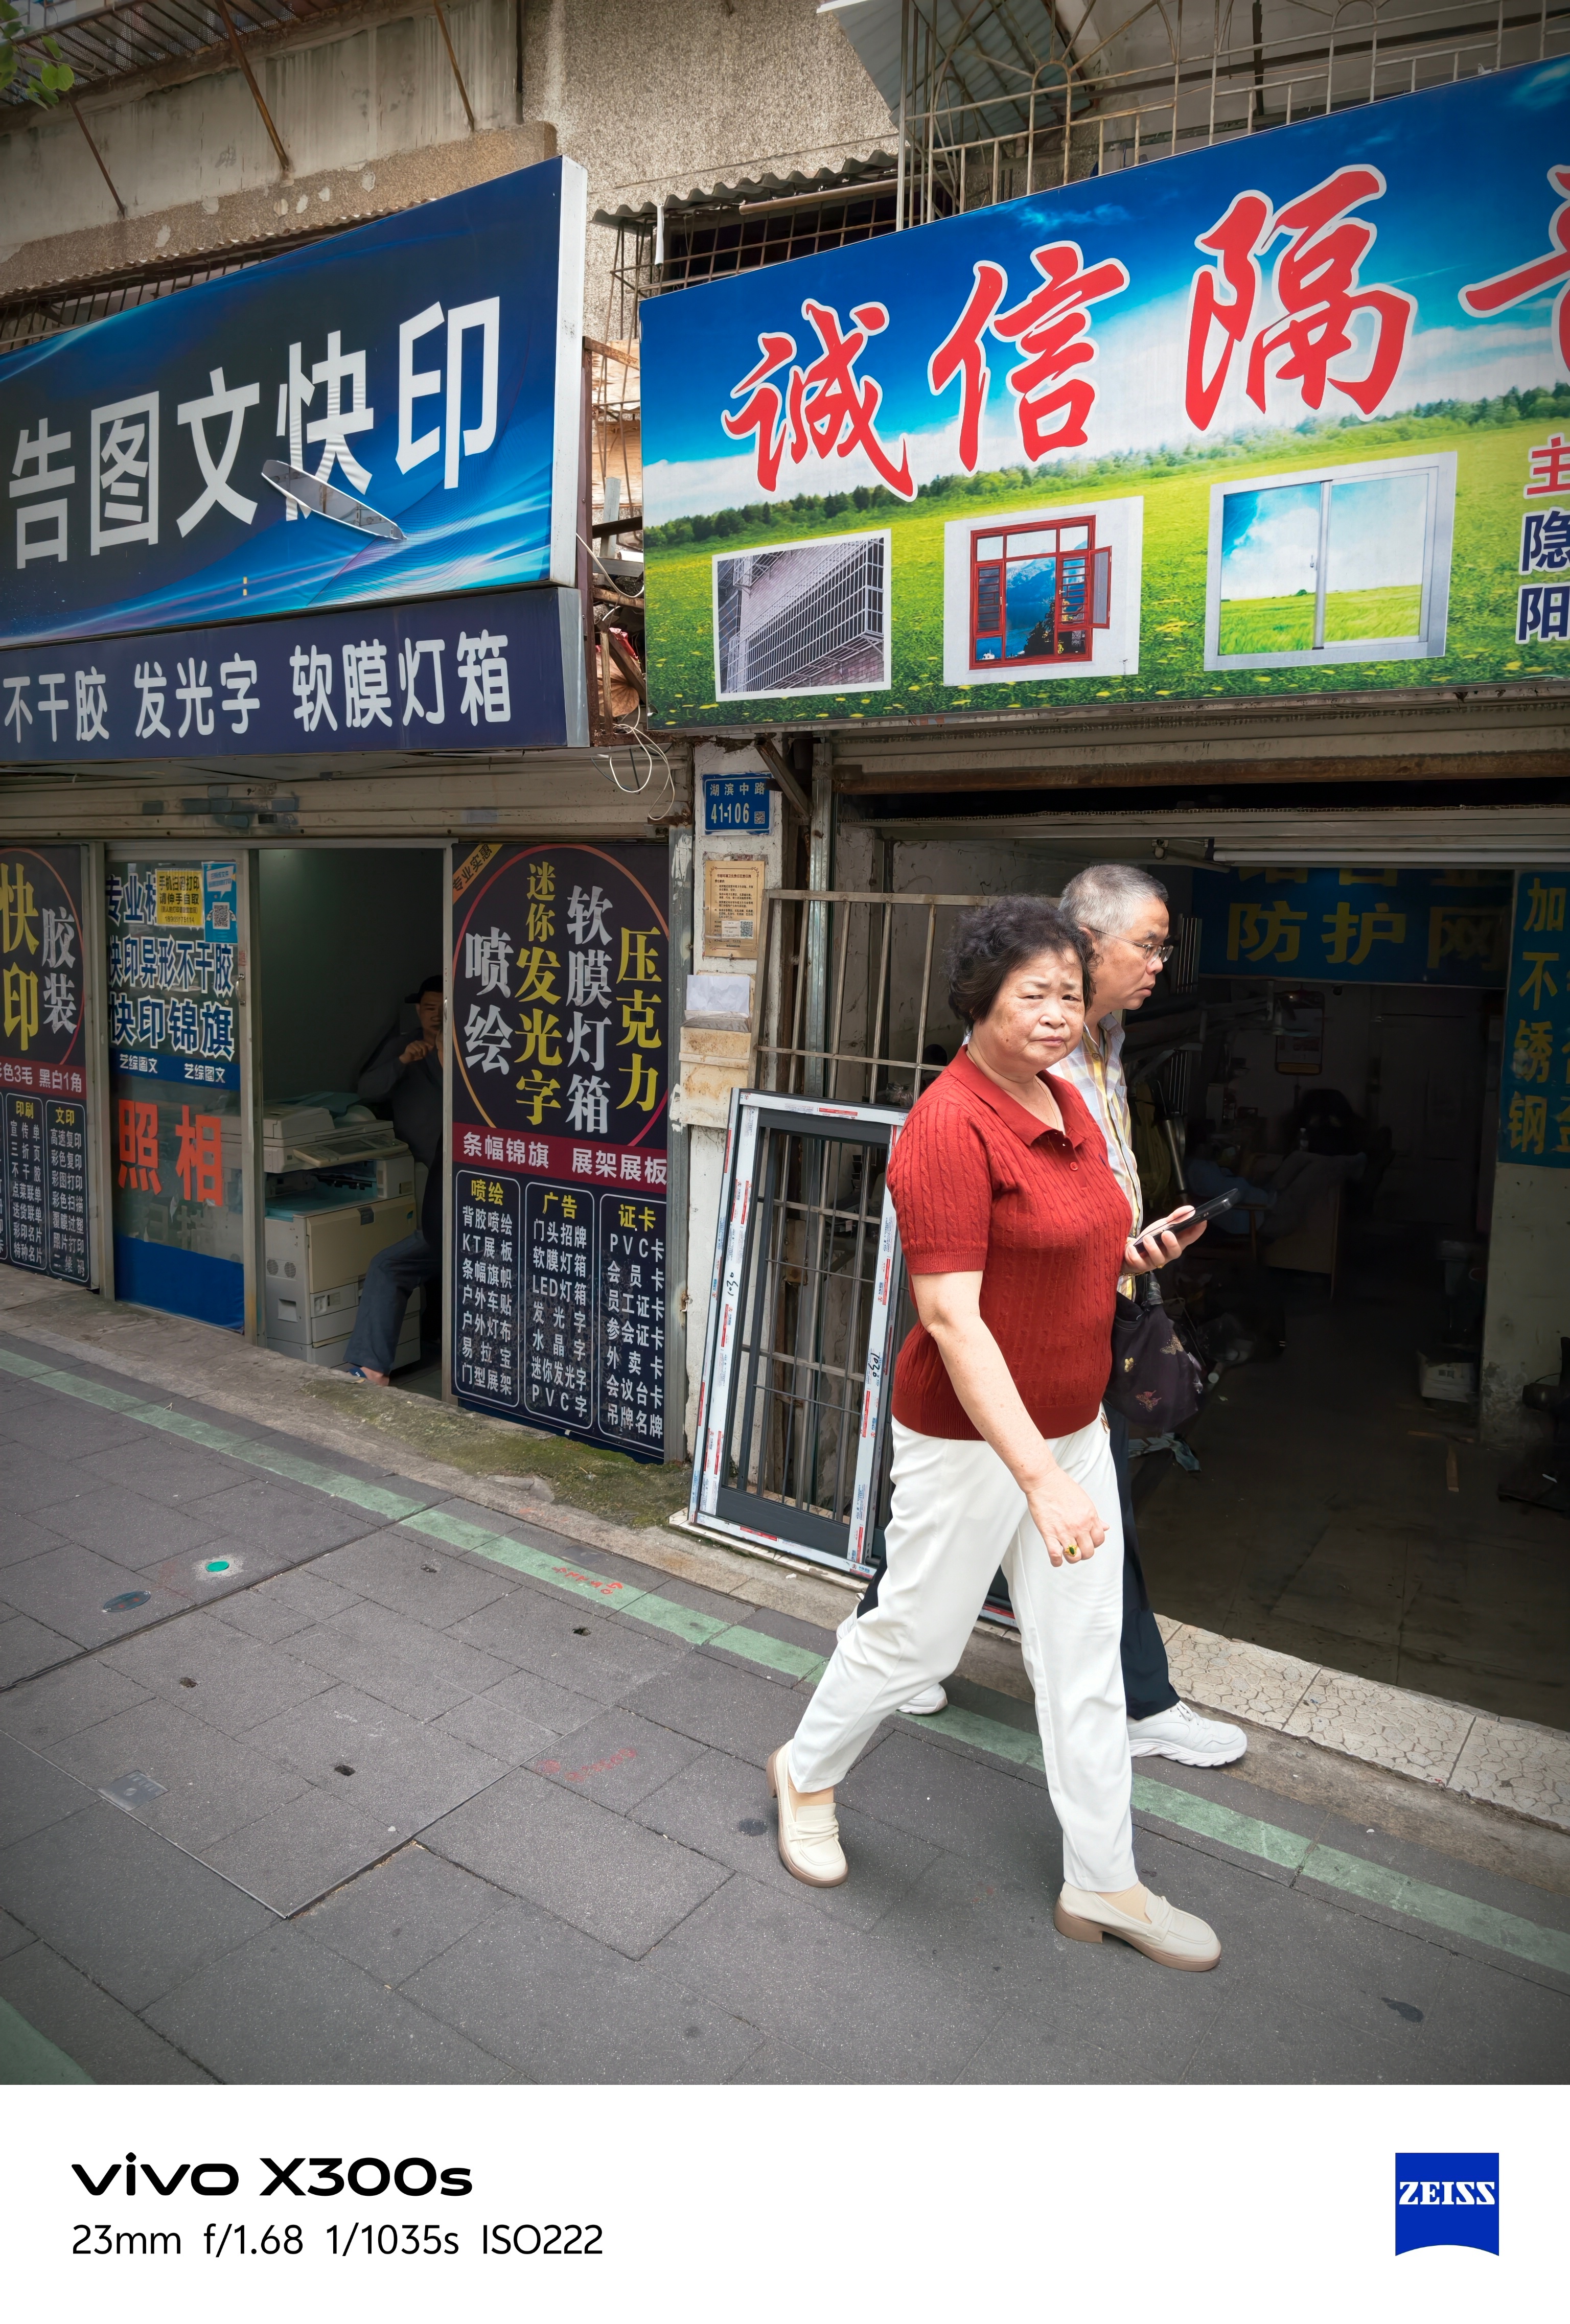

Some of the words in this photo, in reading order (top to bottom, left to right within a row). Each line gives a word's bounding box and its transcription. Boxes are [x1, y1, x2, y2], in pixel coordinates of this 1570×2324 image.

[9, 296, 500, 570] 告图文快印
[1527, 436, 1570, 496] 主
[1522, 511, 1570, 572] 隐
[1518, 586, 1570, 641] 阳
[3, 665, 109, 743] 不干胶
[134, 652, 260, 739] 发光字
[290, 629, 511, 733] 软膜灯箱
[710, 782, 765, 796] 湖滨中路
[711, 803, 750, 824] 41-106
[452, 844, 492, 891] 专业实惠
[159, 893, 199, 905] 请伸手自取
[1226, 901, 1505, 971] 防护网
[0, 863, 39, 1051] 快印
[42, 906, 78, 1034] 胶装
[108, 933, 234, 998] 快印异形不干胶
[464, 926, 514, 1075] 喷绘
[514, 861, 562, 1125] 迷你发光字
[566, 885, 613, 1134] 软膜灯箱
[616, 926, 662, 1112] 压克力
[107, 991, 235, 1062] 快印锦旗
[39, 1068, 82, 1093] 黑白1角
[120, 1054, 158, 1074] 艺综图文
[184, 1063, 226, 1084] 艺综图文
[16, 1100, 34, 1119] 印刷
[55, 1107, 75, 1126] 文印
[10, 1120, 40, 1142] 宣传单
[50, 1128, 82, 1150] 高速复印
[11, 1141, 40, 1163] 三折页
[51, 1149, 82, 1171] 彩色复印
[118, 1099, 224, 1207] 照相
[463, 1132, 549, 1169] 条幅锦旗
[572, 1148, 667, 1185] 展架展板
[11, 1161, 41, 1182] 不干胶
[52, 1170, 83, 1192] 彩图打印
[12, 1183, 42, 1202] 点菜联单
[52, 1191, 83, 1214] 彩色扫描
[471, 1179, 504, 1205] 喷绘
[543, 1192, 577, 1219] 广告
[13, 1201, 42, 1223] 送货联单
[53, 1211, 84, 1235] 覆膜过塑
[462, 1205, 513, 1236] 背胶喷绘
[618, 1204, 656, 1232] 证卡
[13, 1221, 42, 1243] 彩印名片
[53, 1232, 84, 1254] 照片打印
[534, 1218, 587, 1249] 门头招牌
[14, 1242, 42, 1264] 特种名片
[533, 1246, 586, 1277] 软膜灯箱
[462, 1259, 512, 1289] 条幅旗帜
[607, 1260, 664, 1292] 会员卡
[462, 1285, 512, 1316] 户外车贴
[533, 1275, 586, 1306] LED灯箱
[608, 1289, 664, 1321] 员工证卡
[462, 1311, 511, 1342] 户外灯布
[532, 1302, 586, 1334] 发光字
[532, 1332, 586, 1361] 水晶字
[607, 1318, 664, 1350] 参会证卡
[462, 1337, 511, 1369] 易拉宝
[607, 1346, 663, 1379] 外卖卡
[461, 1364, 512, 1396] 门型展架
[531, 1357, 587, 1391] 迷你发光字
[606, 1375, 663, 1409] 会议台卡
[607, 1404, 663, 1439] 吊牌名牌
